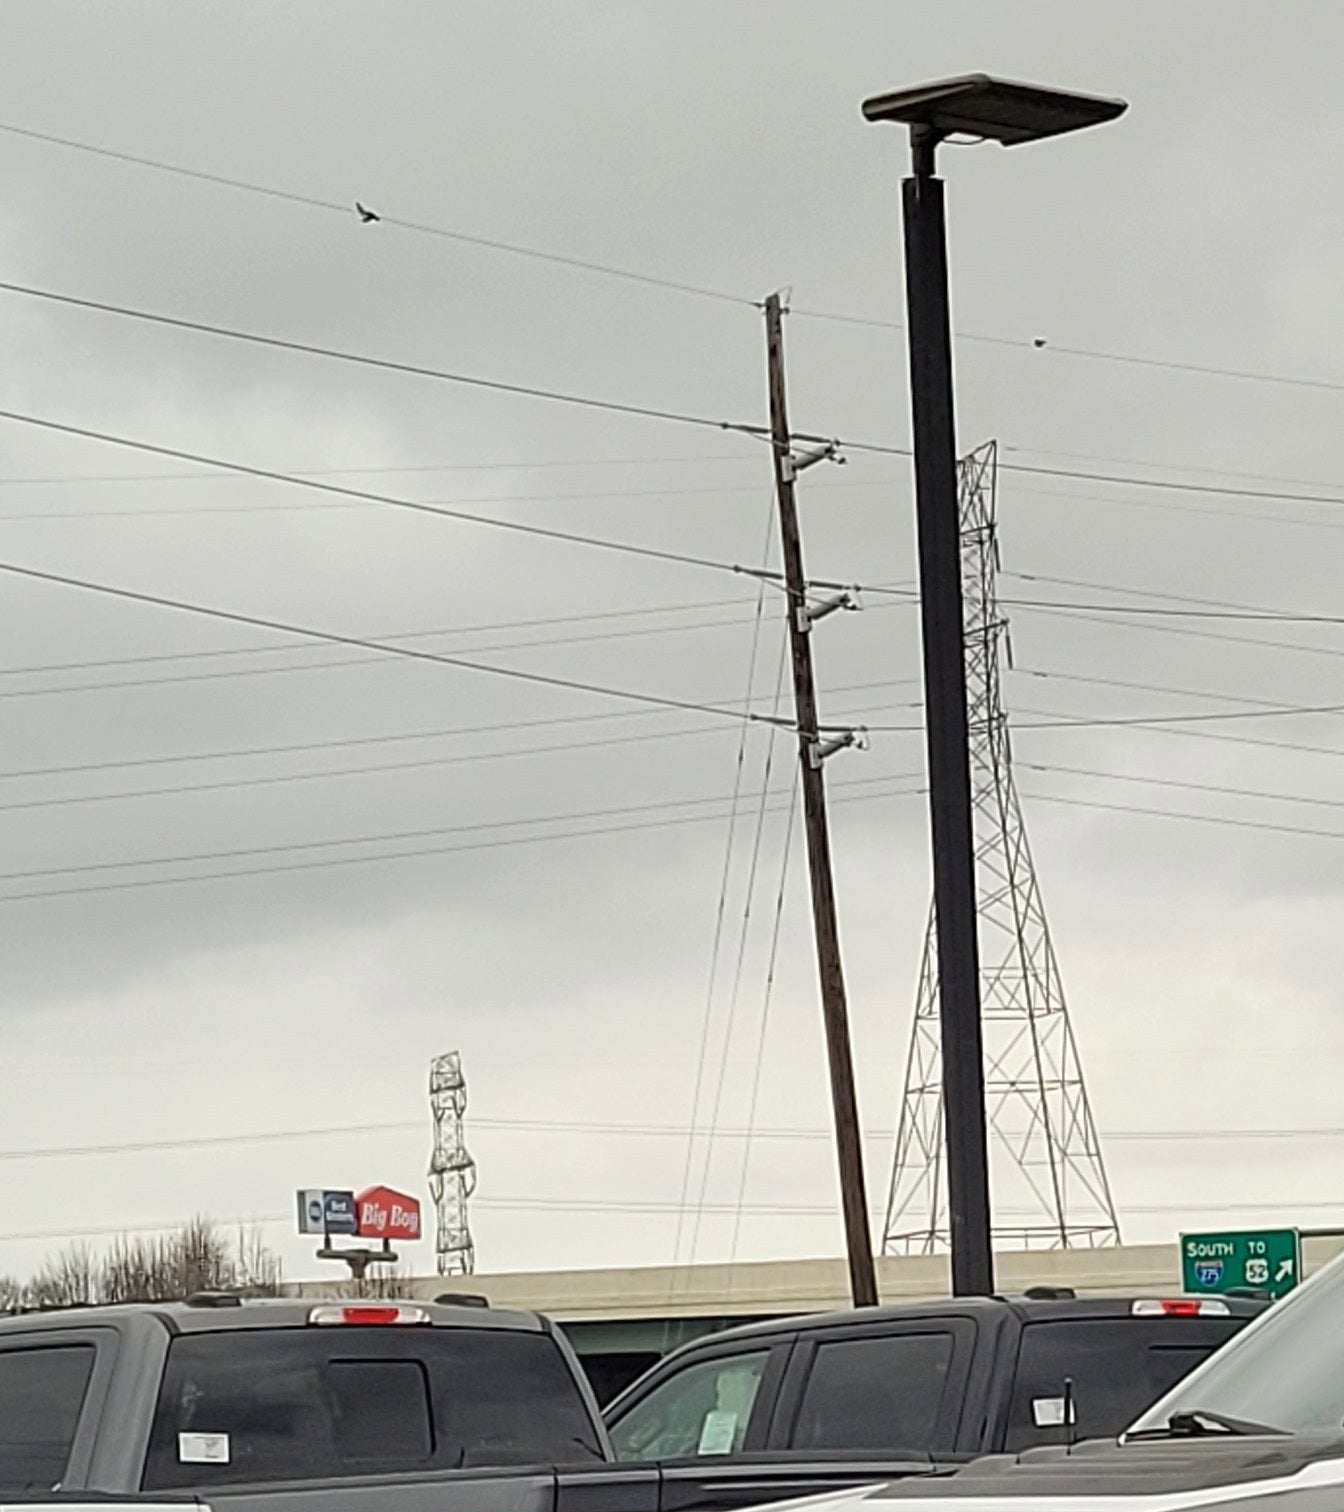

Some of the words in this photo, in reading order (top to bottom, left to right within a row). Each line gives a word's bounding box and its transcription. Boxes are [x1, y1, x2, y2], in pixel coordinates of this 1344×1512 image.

[361, 1202, 387, 1231] Big
[1186, 1242, 1234, 1257] SOUTH
[1247, 1241, 1266, 1254] TO
[1201, 1268, 1219, 1280] 275
[1248, 1264, 1267, 1279] 52
